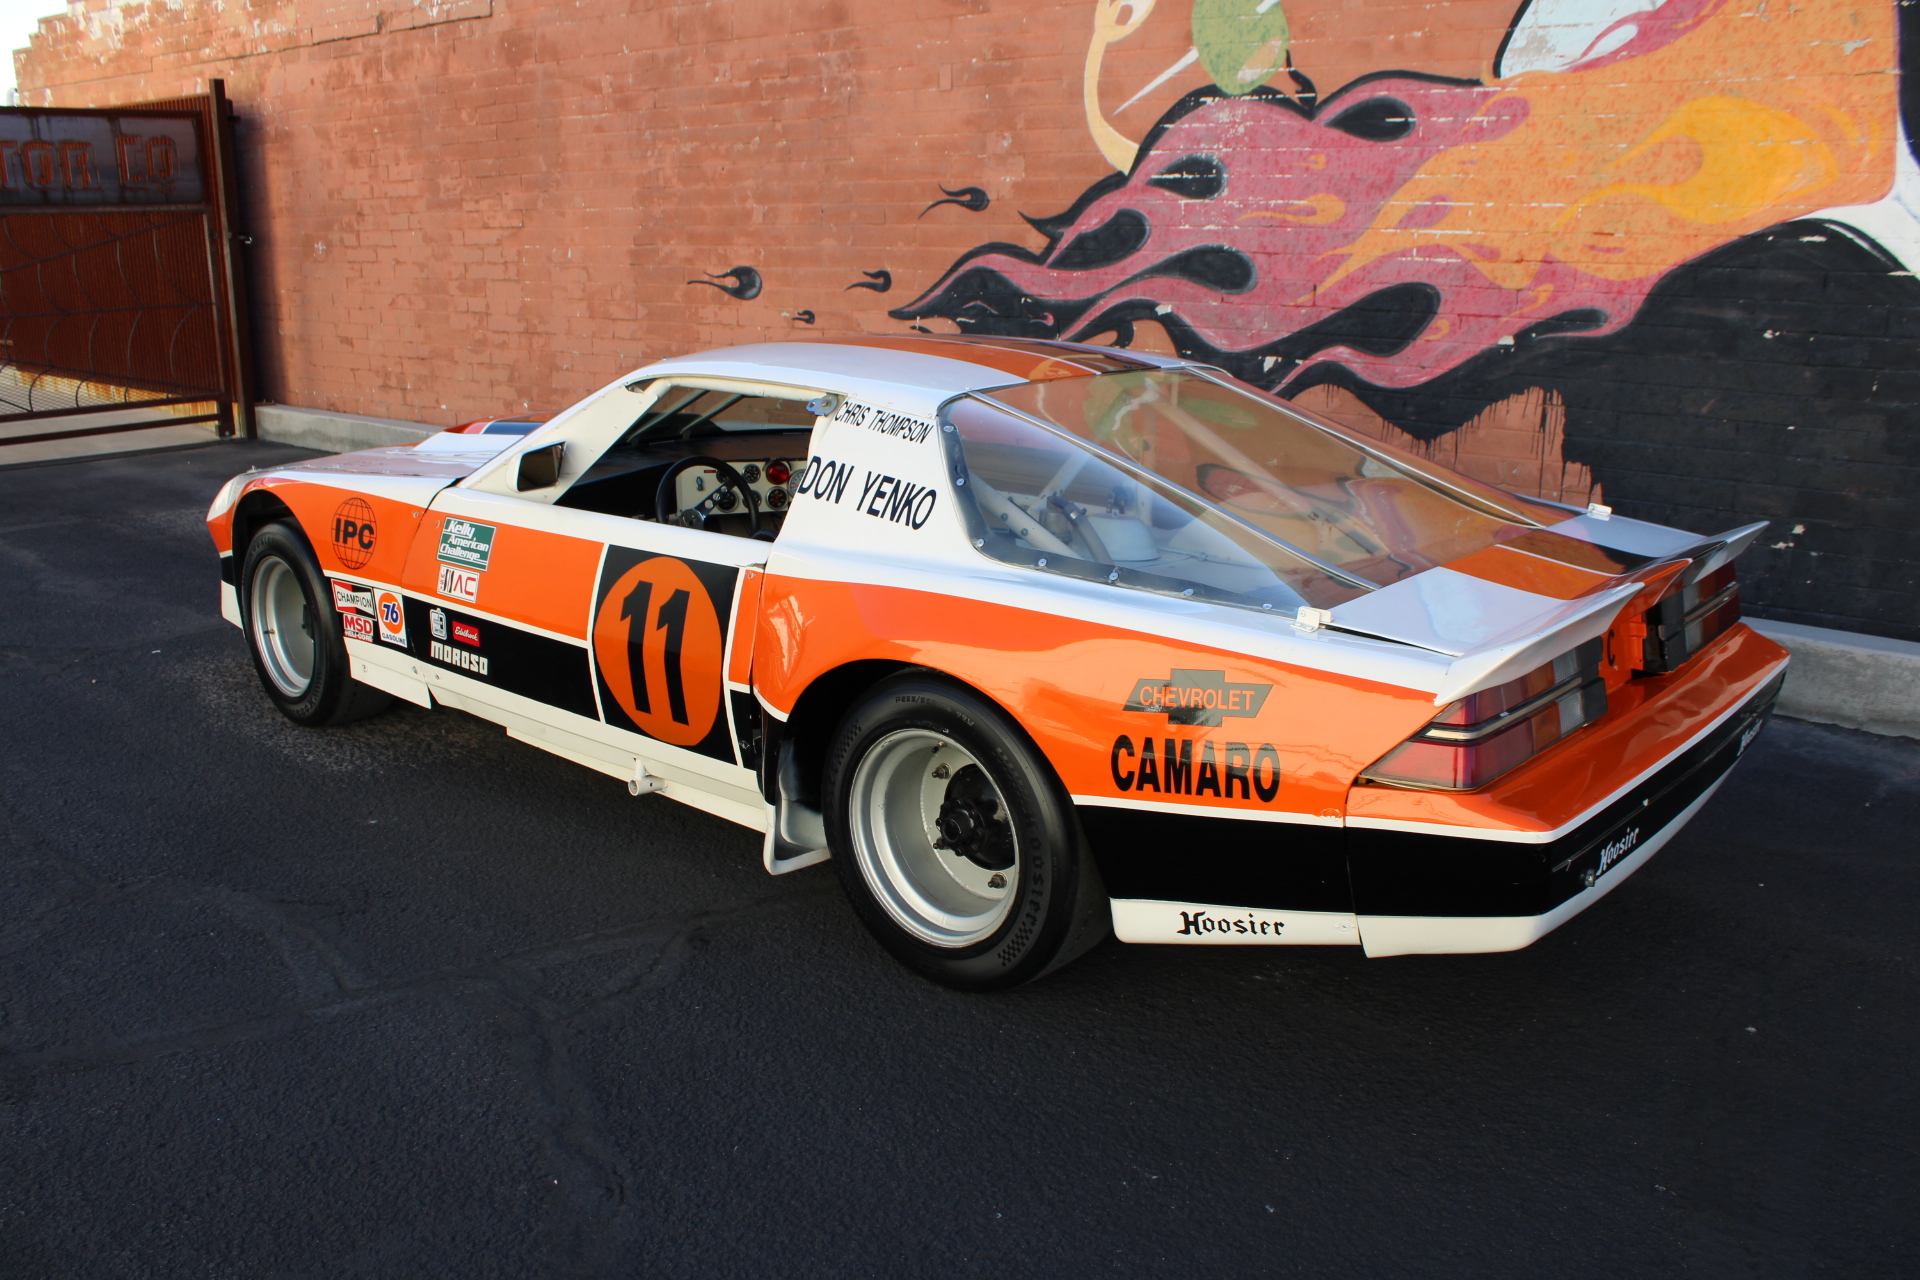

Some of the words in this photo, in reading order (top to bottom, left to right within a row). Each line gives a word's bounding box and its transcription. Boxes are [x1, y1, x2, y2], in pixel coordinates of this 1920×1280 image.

[834, 401, 870, 427] CHRIS
[868, 410, 934, 444] THOMPSON
[797, 455, 855, 504] DON
[856, 471, 937, 530] YENKO
[335, 518, 375, 550] IPC
[447, 520, 475, 539] Kelly
[440, 544, 481, 562] Challenge
[448, 536, 489, 553] American
[336, 590, 373, 609] CHAMPION
[345, 615, 373, 635] MSD
[382, 602, 399, 624] 76
[381, 632, 406, 646] GASOLINE
[620, 580, 691, 727] 11
[1139, 686, 1255, 711] CHEVROLET
[1111, 734, 1280, 803] CAMARO
[1596, 827, 1640, 876] Hoosier
[1177, 911, 1285, 936] Hoosier
